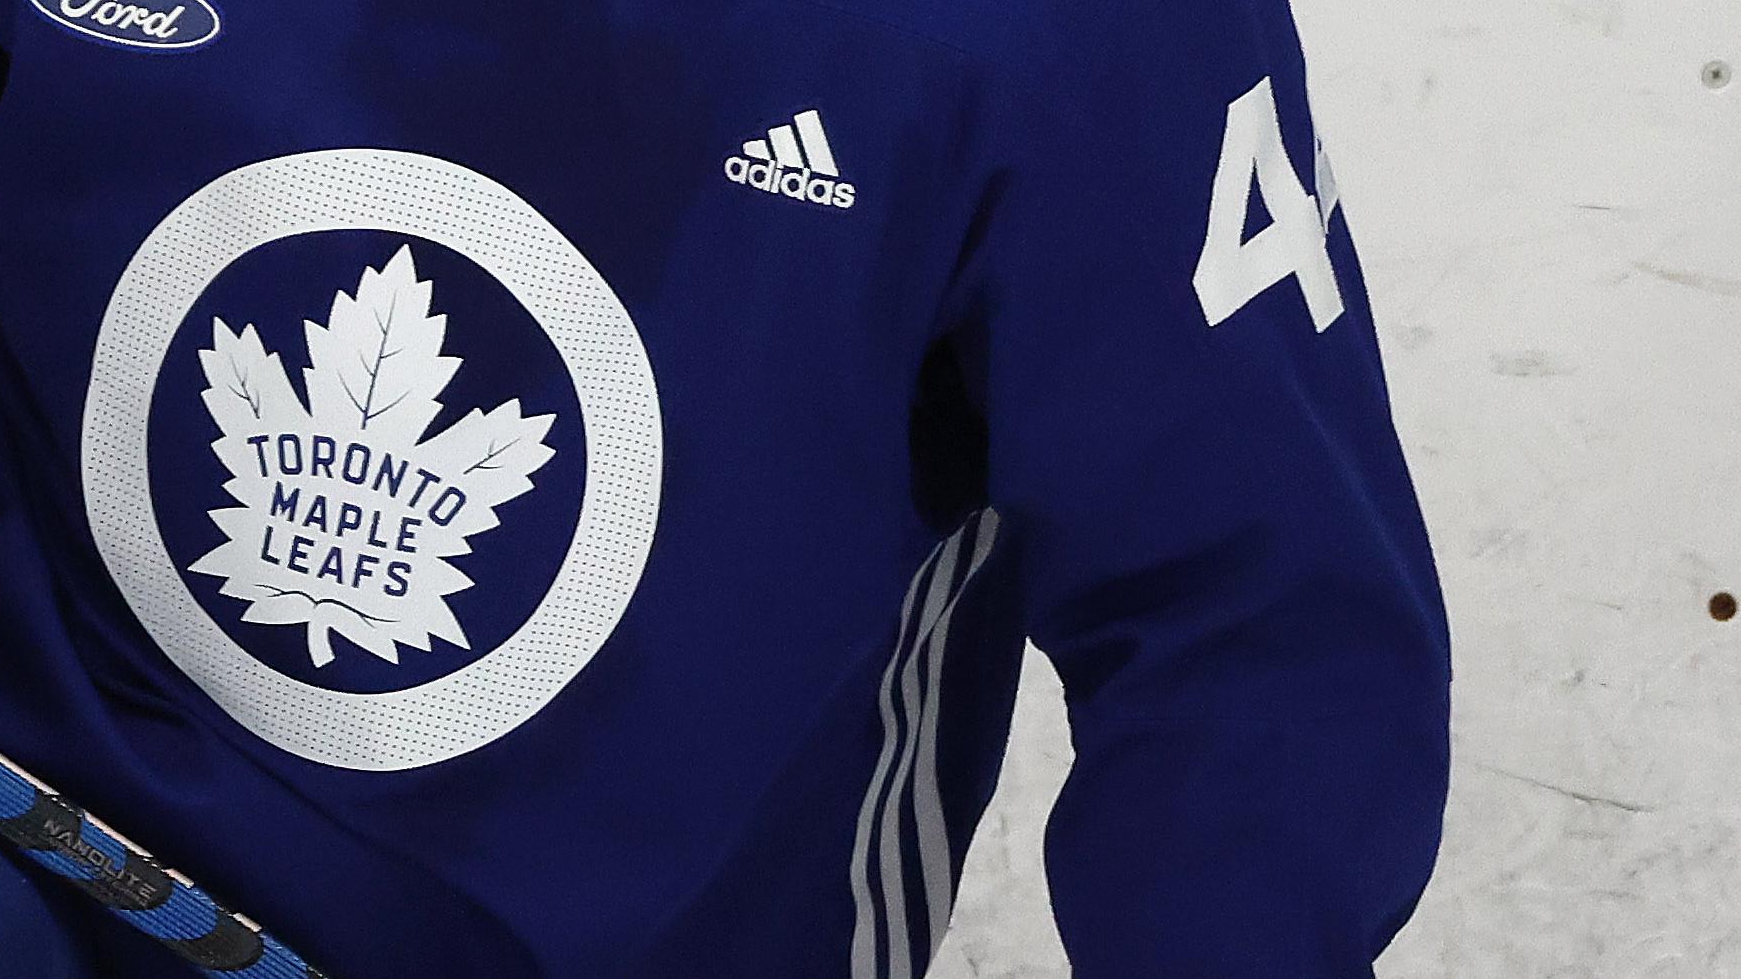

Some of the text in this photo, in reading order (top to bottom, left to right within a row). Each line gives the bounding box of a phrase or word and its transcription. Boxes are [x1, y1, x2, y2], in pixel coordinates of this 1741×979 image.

[725, 155, 856, 209] adidas
[1192, 75, 1345, 334] 4
[247, 433, 467, 527] TORONTO
[270, 481, 424, 554] MAPLE
[260, 525, 414, 598] LEAFS
